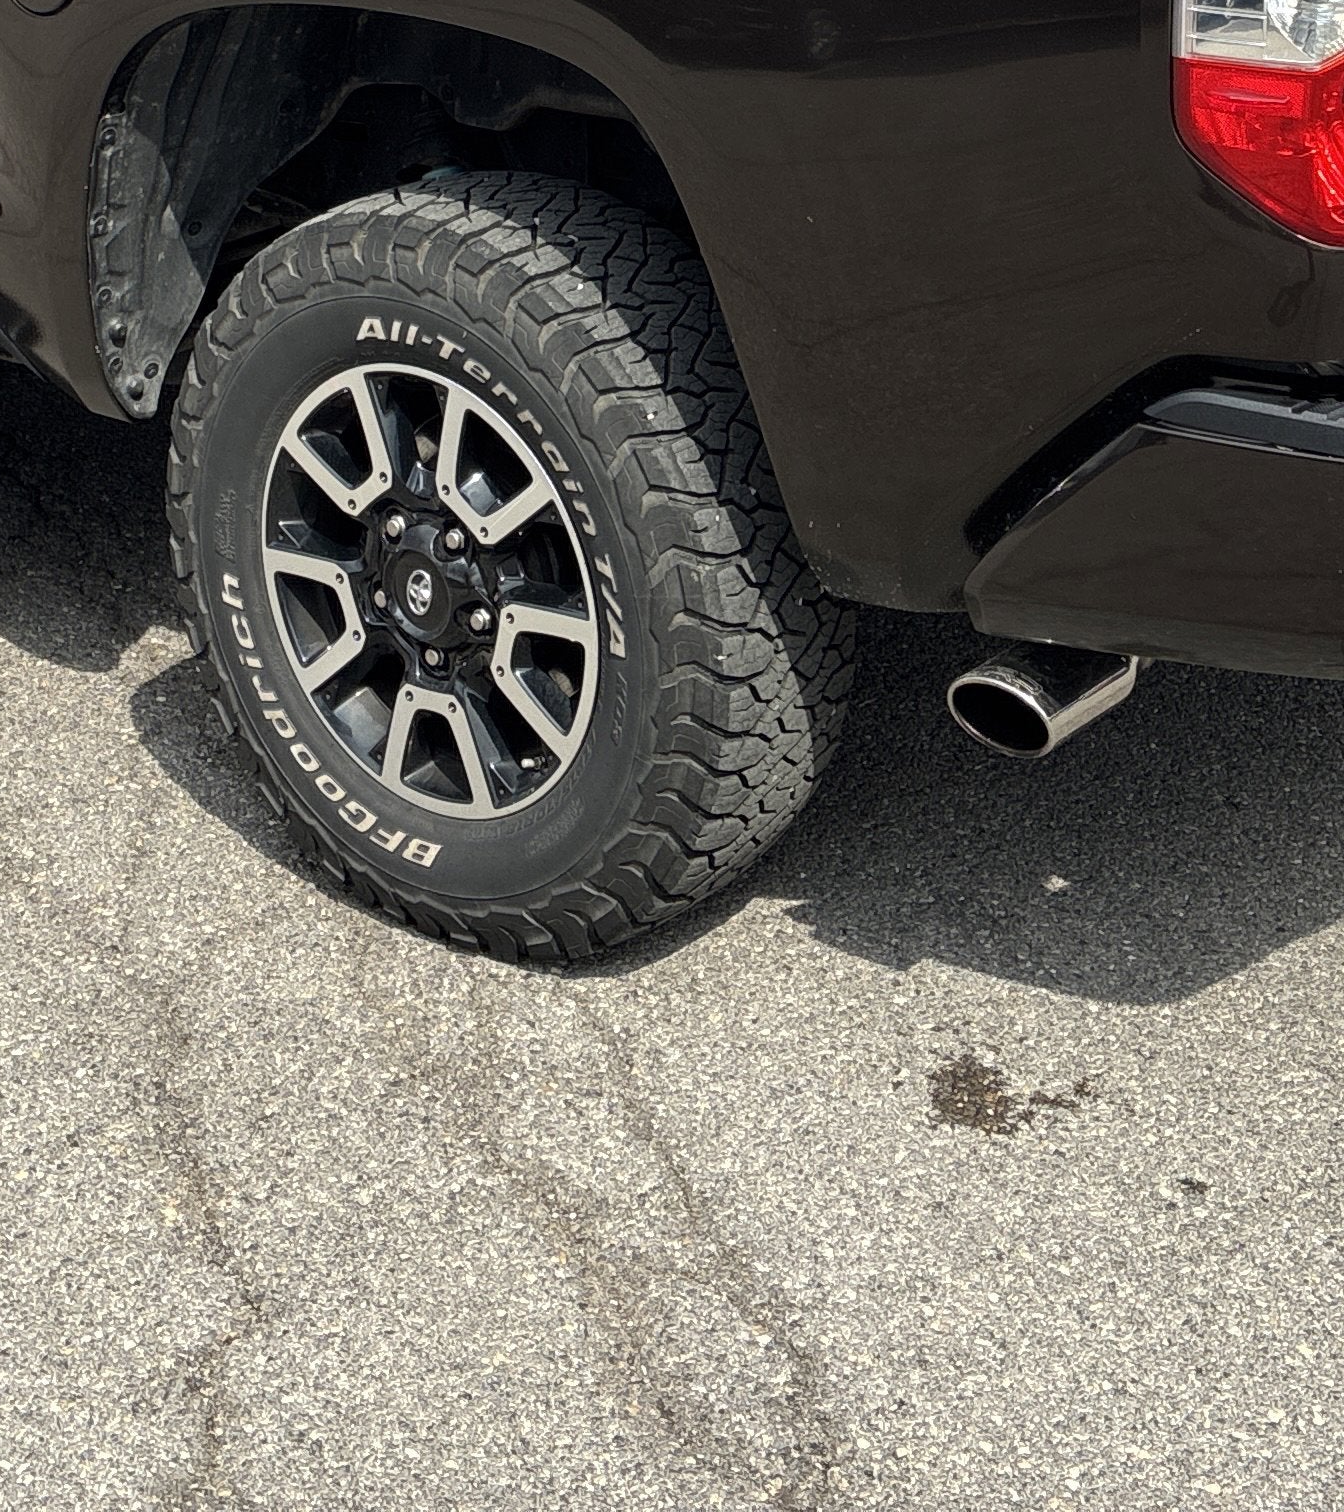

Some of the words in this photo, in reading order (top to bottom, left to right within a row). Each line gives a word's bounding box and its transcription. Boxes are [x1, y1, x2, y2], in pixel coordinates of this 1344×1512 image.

[356, 315, 597, 537] All-Terrain
[593, 553, 627, 660] T/A
[221, 572, 443, 869] BFGoodrich
